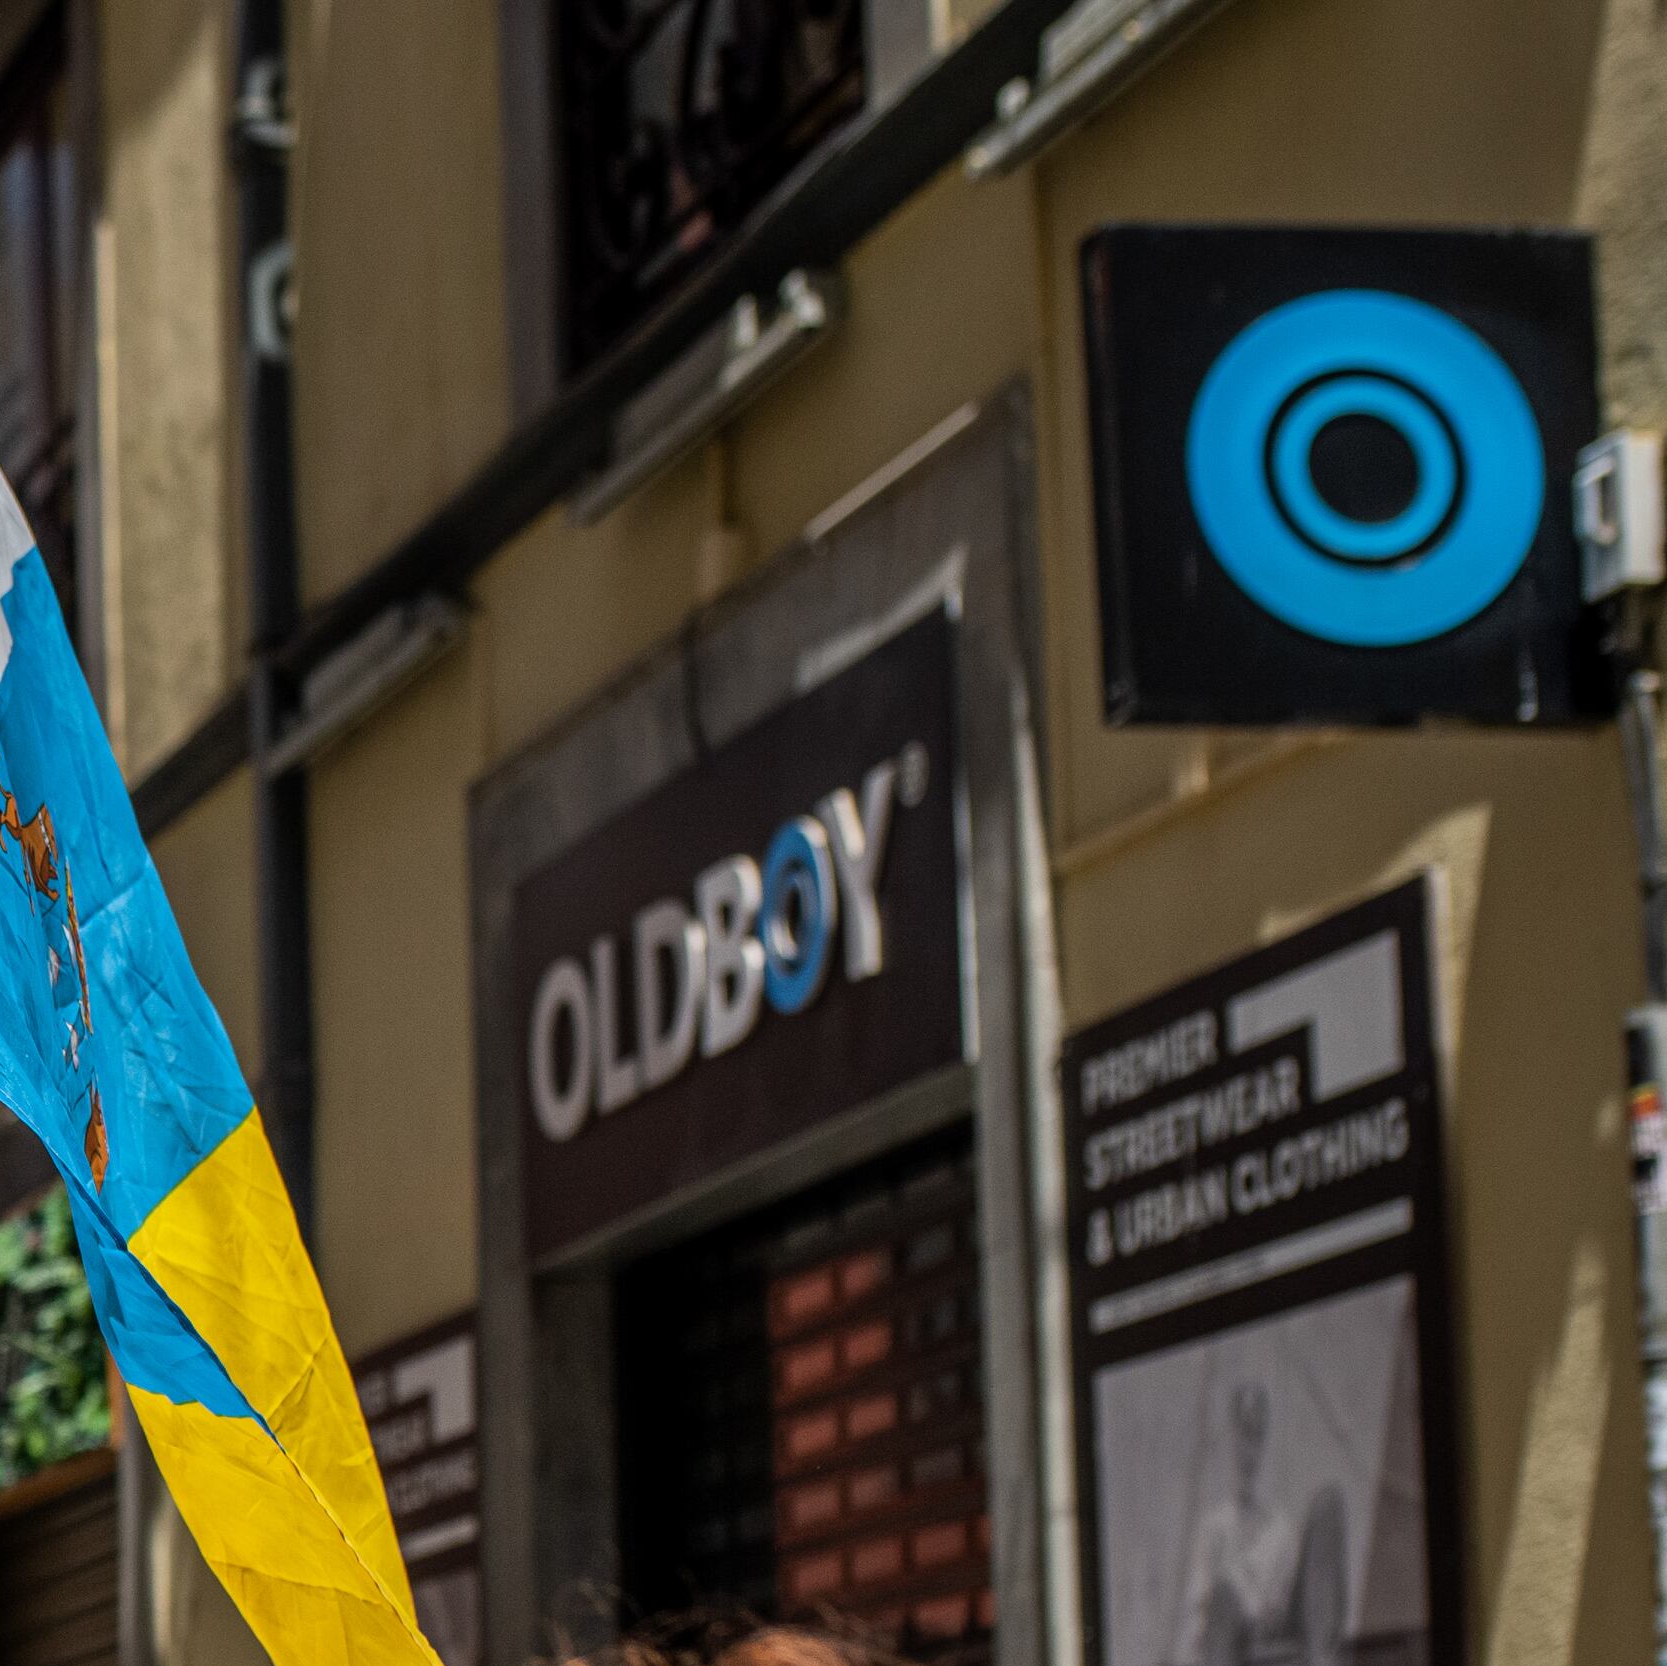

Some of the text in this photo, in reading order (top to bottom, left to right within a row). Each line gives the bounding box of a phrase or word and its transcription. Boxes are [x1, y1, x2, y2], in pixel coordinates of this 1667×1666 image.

[529, 760, 897, 1143] OLDBOY
[1080, 1010, 1218, 1117] PREMIER
[1083, 1055, 1301, 1192] STREETWEAR
[1116, 1163, 1230, 1257] URBAN
[1231, 1099, 1410, 1215] CLOTHING
